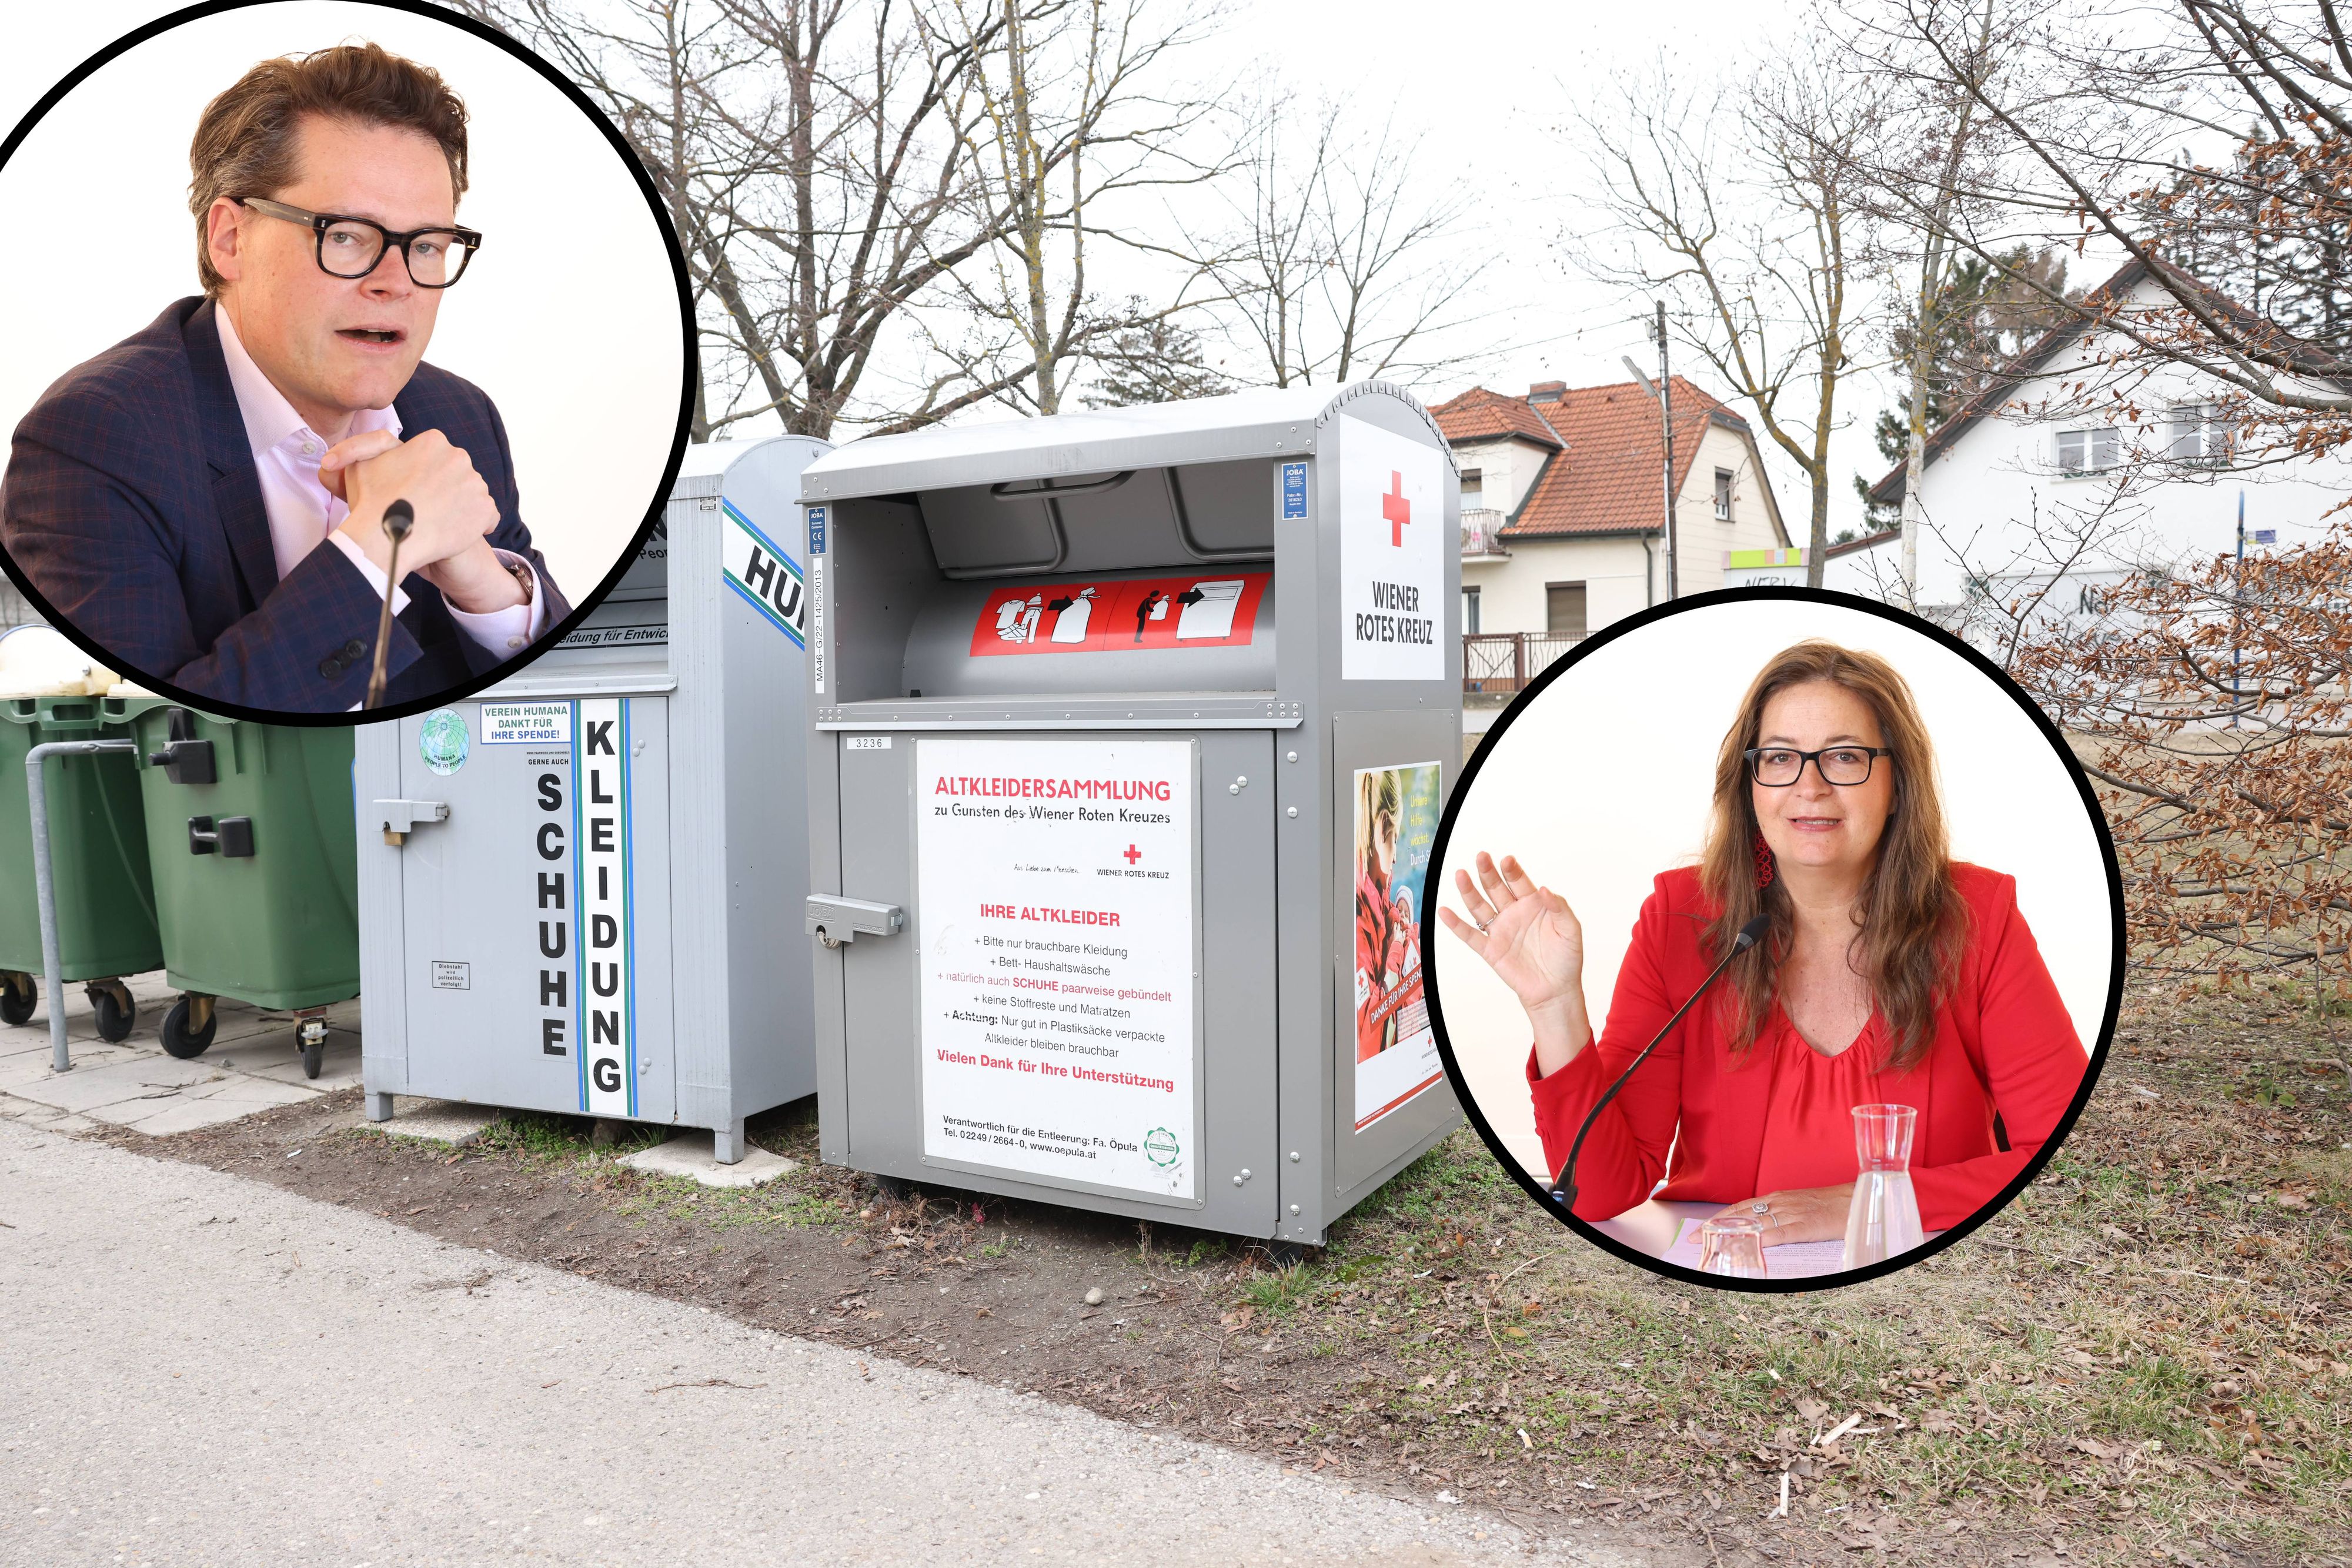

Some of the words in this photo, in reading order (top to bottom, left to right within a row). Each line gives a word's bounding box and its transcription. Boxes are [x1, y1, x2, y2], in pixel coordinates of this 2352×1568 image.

[744, 544, 804, 631] HU
[1372, 581, 1419, 612] WIENER
[604, 629, 623, 641] für
[1357, 613, 1394, 643] ROTES
[1398, 617, 1433, 645] KREUZ
[485, 707, 521, 717] VEREIN
[524, 706, 568, 716] HUMANA
[498, 718, 530, 728] DANKT
[533, 717, 552, 727] FÜR
[491, 731, 514, 740] IHRE
[517, 730, 560, 739] SPENDE!
[856, 738, 883, 748] 3236
[425, 756, 442, 768] PEOPLE
[449, 754, 466, 768] PEOPLE
[433, 754, 456, 762] HUMANA
[935, 777, 1170, 801] ALTKLEIDERSAMMLUNG
[1410, 795, 1428, 808] Unsere
[934, 806, 947, 815] zu
[952, 803, 1000, 817] Gunsten
[1004, 804, 1025, 819] des
[1029, 805, 1075, 820] Wiener
[1078, 807, 1114, 821] Roten
[1120, 808, 1171, 824] Kreuzes
[1410, 813, 1422, 827] Hilfe
[1410, 832, 1430, 846] wächst.
[1014, 863, 1023, 871] Aus
[1025, 863, 1039, 872] Liebe
[1410, 851, 1425, 866] Durch
[1097, 868, 1122, 877] WIENER
[1147, 871, 1170, 879] KREUZ
[536, 773, 567, 1057] SCHUHE
[586, 720, 622, 1094] KLEIDUNG
[980, 904, 1016, 920] IHRE
[1020, 906, 1121, 927] ALTKLEIDER
[983, 935, 1004, 947] Bitte
[1007, 940, 1023, 948] nur
[1025, 939, 1081, 954] brauchbare
[1083, 943, 1128, 960] Kleidung
[999, 956, 1021, 968] Bett-
[1024, 958, 1111, 977] Haushaltswäsche
[946, 972, 985, 984] natürlich
[987, 976, 1010, 987] auch
[1013, 977, 1059, 991] SCHUHE
[1061, 984, 1115, 997] paarweise
[1118, 988, 1172, 1002] gebündelt
[982, 994, 1007, 1006] keine
[1010, 996, 1056, 1011] Stoffreste
[1059, 1002, 1077, 1013] und
[1371, 999, 1388, 1024] DANKE
[1388, 991, 1398, 1007] FÜR
[1398, 979, 1409, 998] IHRE
[952, 1009, 998, 1025] Achtung:
[1001, 1015, 1019, 1027] Nur
[1021, 1019, 1036, 1030] gut
[1039, 1019, 1047, 1029] in
[1051, 1020, 1112, 1037] Plastiksäcke
[1115, 1029, 1165, 1042] verpackte
[984, 1032, 1028, 1047] Altkleider
[1031, 1038, 1065, 1052] bleiben
[1068, 1042, 1119, 1058] brauchbar
[937, 1049, 976, 1065] Vielen
[980, 1054, 1014, 1070] Dank
[1018, 1059, 1037, 1073] für
[1041, 1062, 1068, 1077] Ihre
[1073, 1066, 1174, 1093] Unterstützung
[943, 1115, 1005, 1132] Verantwortlich
[1007, 1125, 1020, 1135] für
[1022, 1127, 1036, 1137] die
[1038, 1129, 1090, 1146] Entleerung:
[1093, 1137, 1107, 1148] Fa.
[943, 1127, 958, 1138] Tel.
[1030, 1142, 1097, 1159] www.oepula.at
